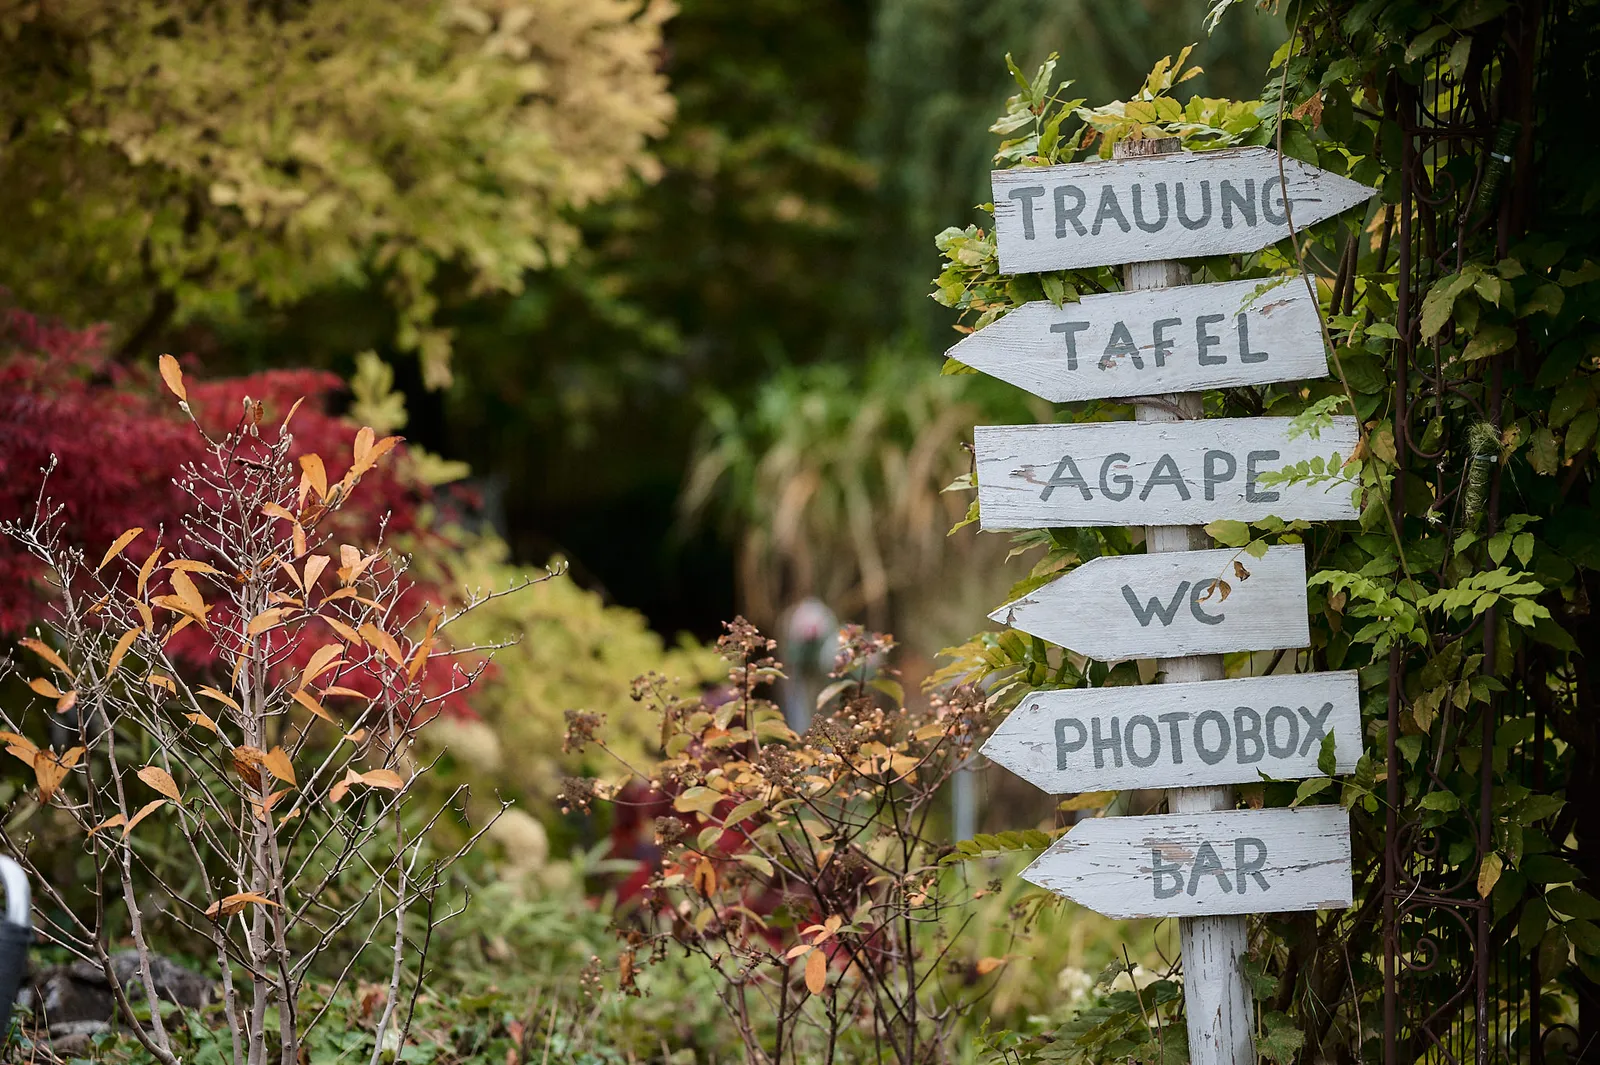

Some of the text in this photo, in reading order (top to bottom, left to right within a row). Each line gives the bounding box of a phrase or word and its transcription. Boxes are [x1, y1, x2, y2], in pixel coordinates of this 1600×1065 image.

[1008, 175, 1294, 241] TRAUUNG
[1049, 312, 1269, 371] TAFEL
[1039, 449, 1280, 503] AGAPE
[1120, 578, 1225, 627] WC
[1054, 701, 1334, 771] PHOTOBOX
[1151, 837, 1271, 899] BAR
